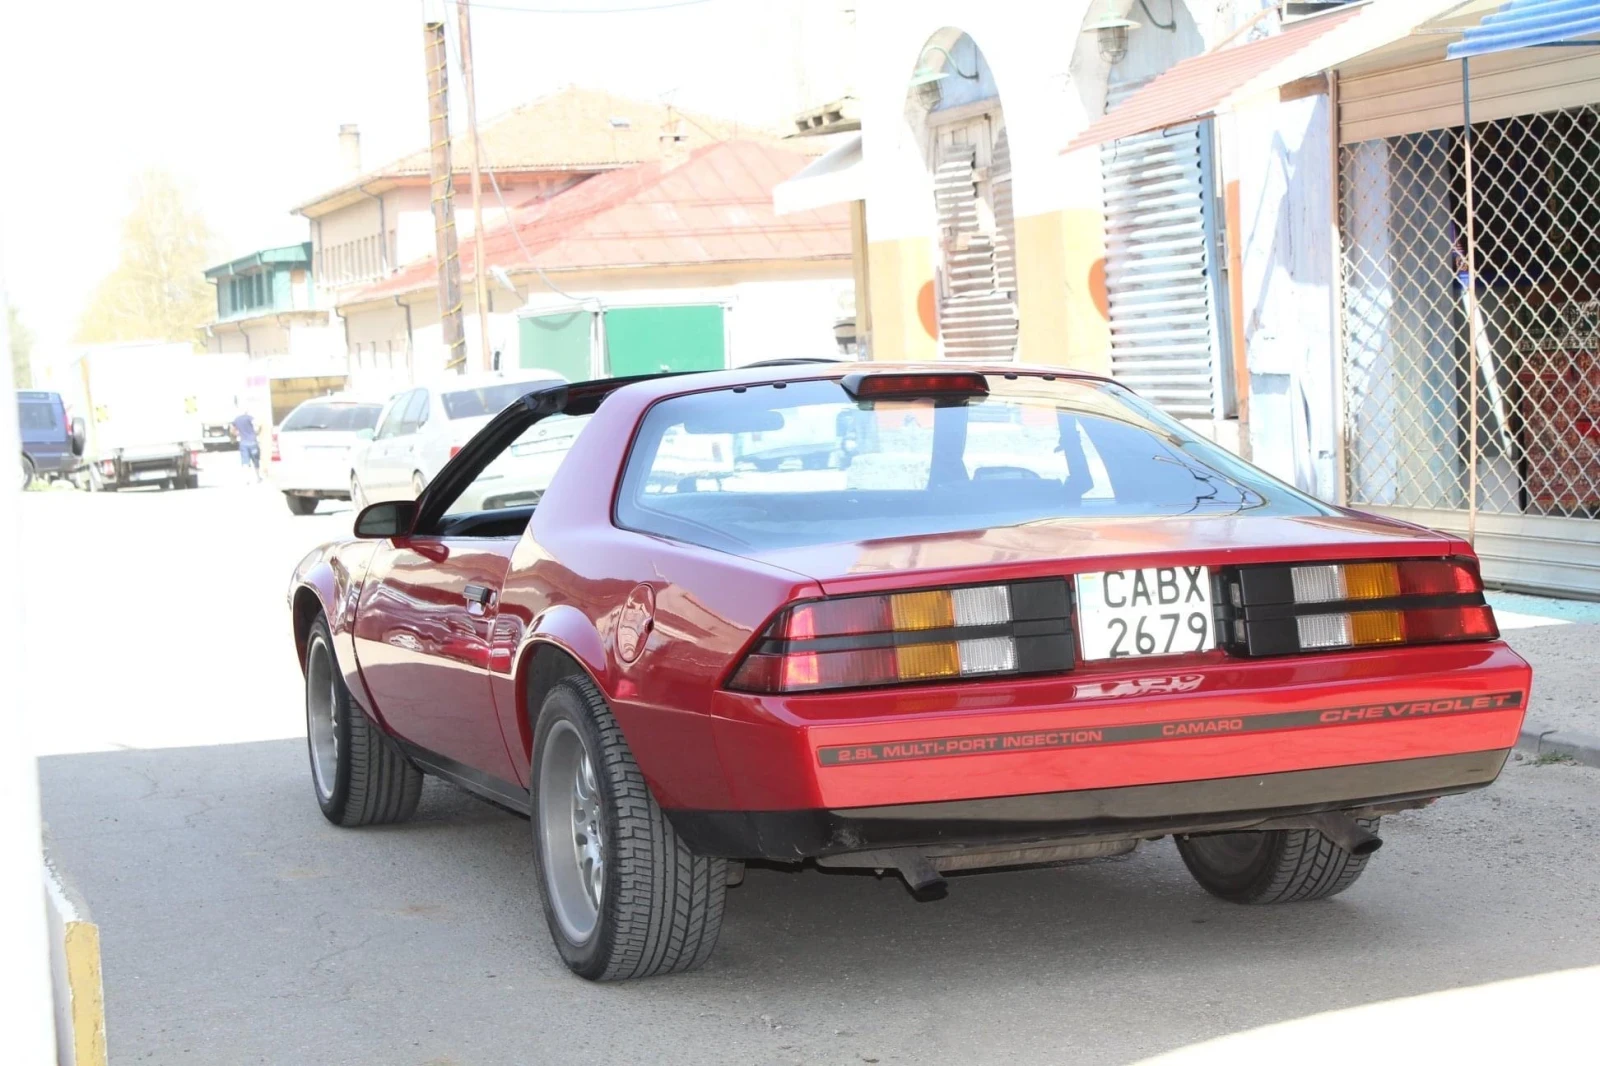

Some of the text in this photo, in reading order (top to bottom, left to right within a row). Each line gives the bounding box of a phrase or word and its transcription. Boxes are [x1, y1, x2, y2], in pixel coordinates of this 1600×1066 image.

[1103, 565, 1205, 608] CABX
[1107, 612, 1207, 658] 2679
[1319, 694, 1512, 723] CHEVROLET
[1162, 718, 1243, 736] CAMARO
[838, 730, 1103, 763] 2.8L MULTI-PORT INGECTION
